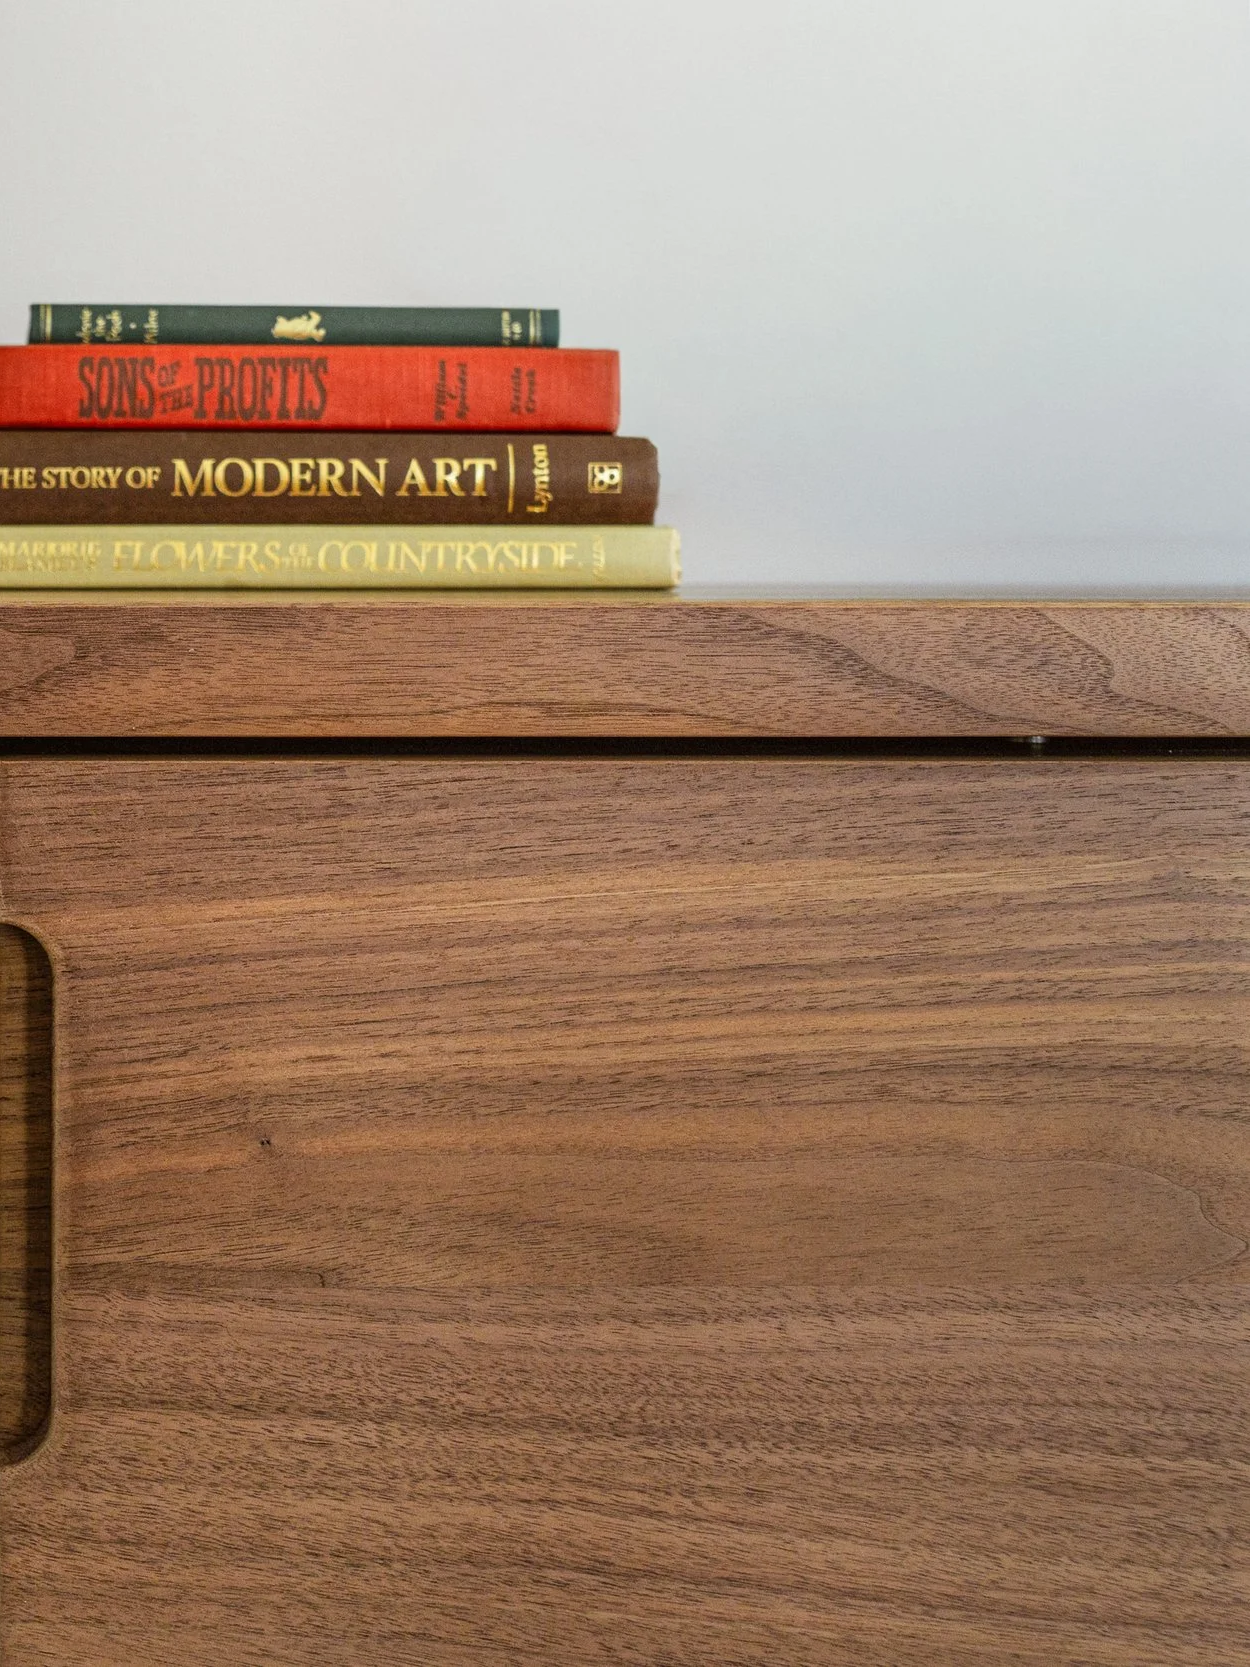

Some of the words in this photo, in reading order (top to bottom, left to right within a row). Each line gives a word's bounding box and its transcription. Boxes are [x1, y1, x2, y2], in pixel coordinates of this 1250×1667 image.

[78, 356, 155, 420] SONS
[157, 360, 181, 388] OF
[193, 356, 328, 421] PROFITS
[160, 384, 194, 415] THE
[41, 466, 123, 489] STORY
[125, 466, 162, 489] OF
[171, 457, 389, 498] MODERN
[395, 457, 497, 497] ART
[526, 443, 554, 513] Lynton
[113, 540, 282, 573] FLOWERS
[317, 540, 581, 574] COUNTRYSIDE
